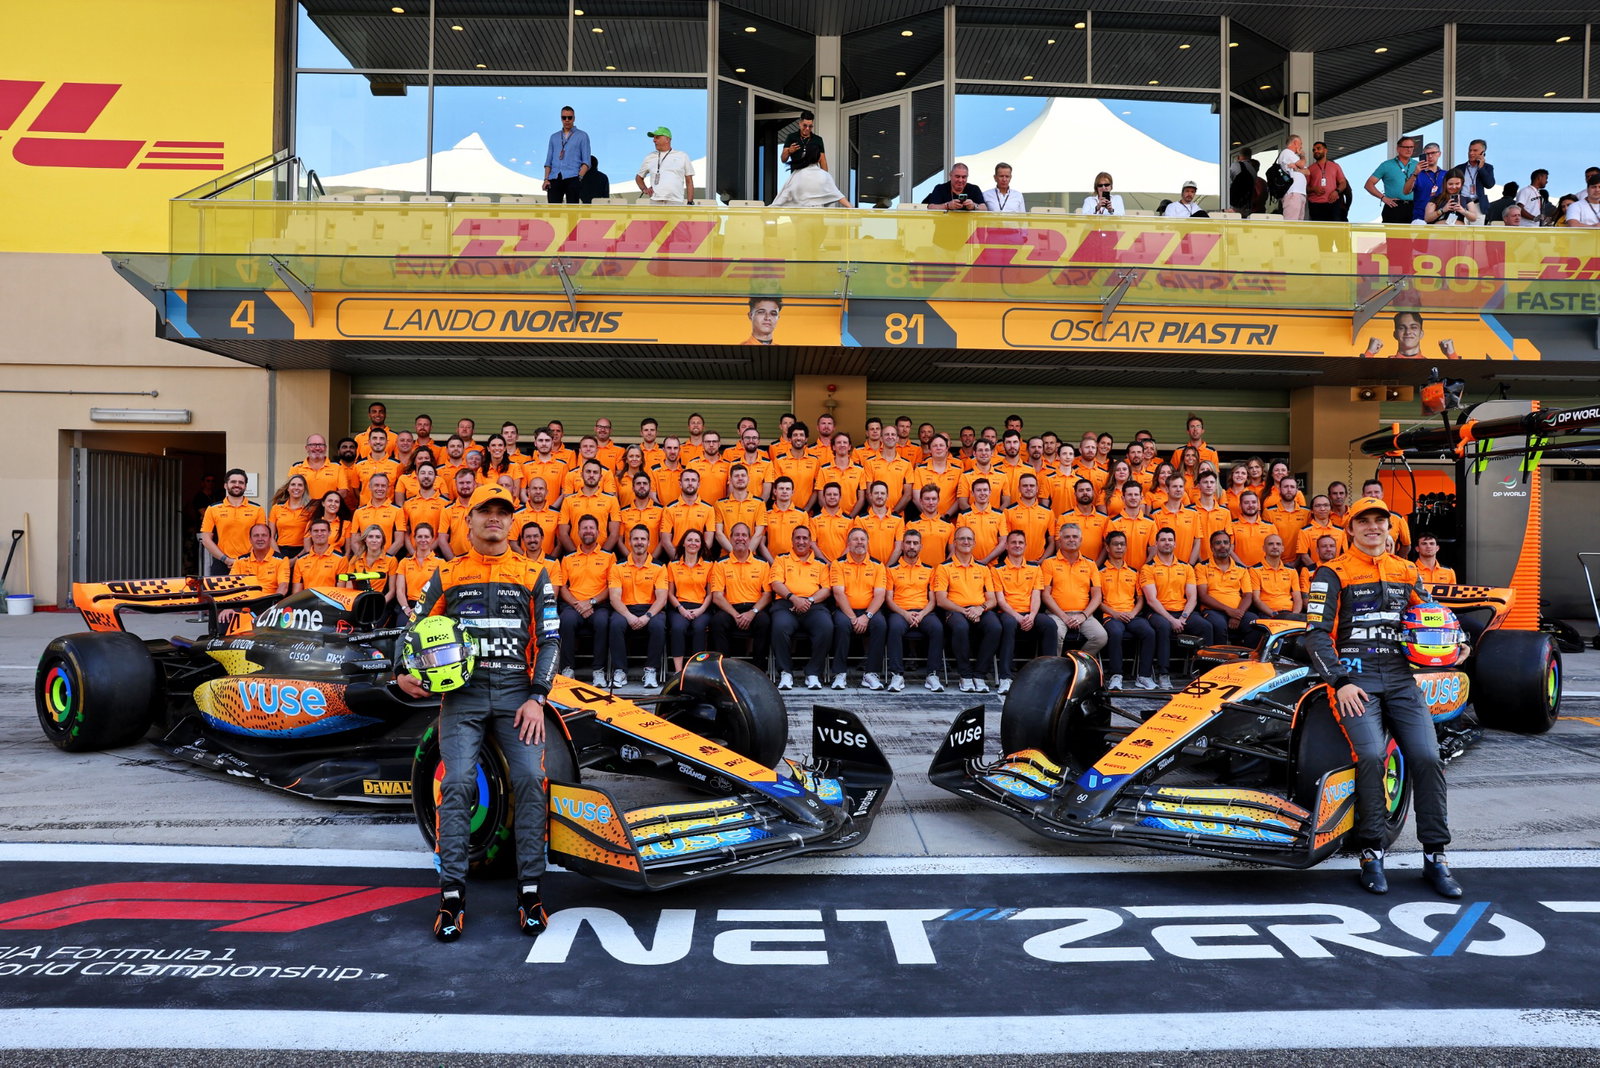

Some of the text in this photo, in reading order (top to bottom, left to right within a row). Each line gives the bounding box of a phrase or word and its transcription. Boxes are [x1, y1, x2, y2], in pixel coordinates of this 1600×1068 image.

[230, 300, 255, 334] 4
[383, 309, 623, 333] LANDO NORRIS
[884, 313, 925, 345] 81
[1050, 318, 1279, 346] OSCAR PIASTRI
[1558, 408, 1600, 423] DP WORL
[570, 687, 616, 704] 4
[364, 781, 412, 794] DEWAL
[525, 907, 950, 965] NET
[46, 946, 210, 960] Formula
[212, 947, 236, 961] 1
[0, 961, 81, 976] orld
[80, 962, 363, 982] Championship
